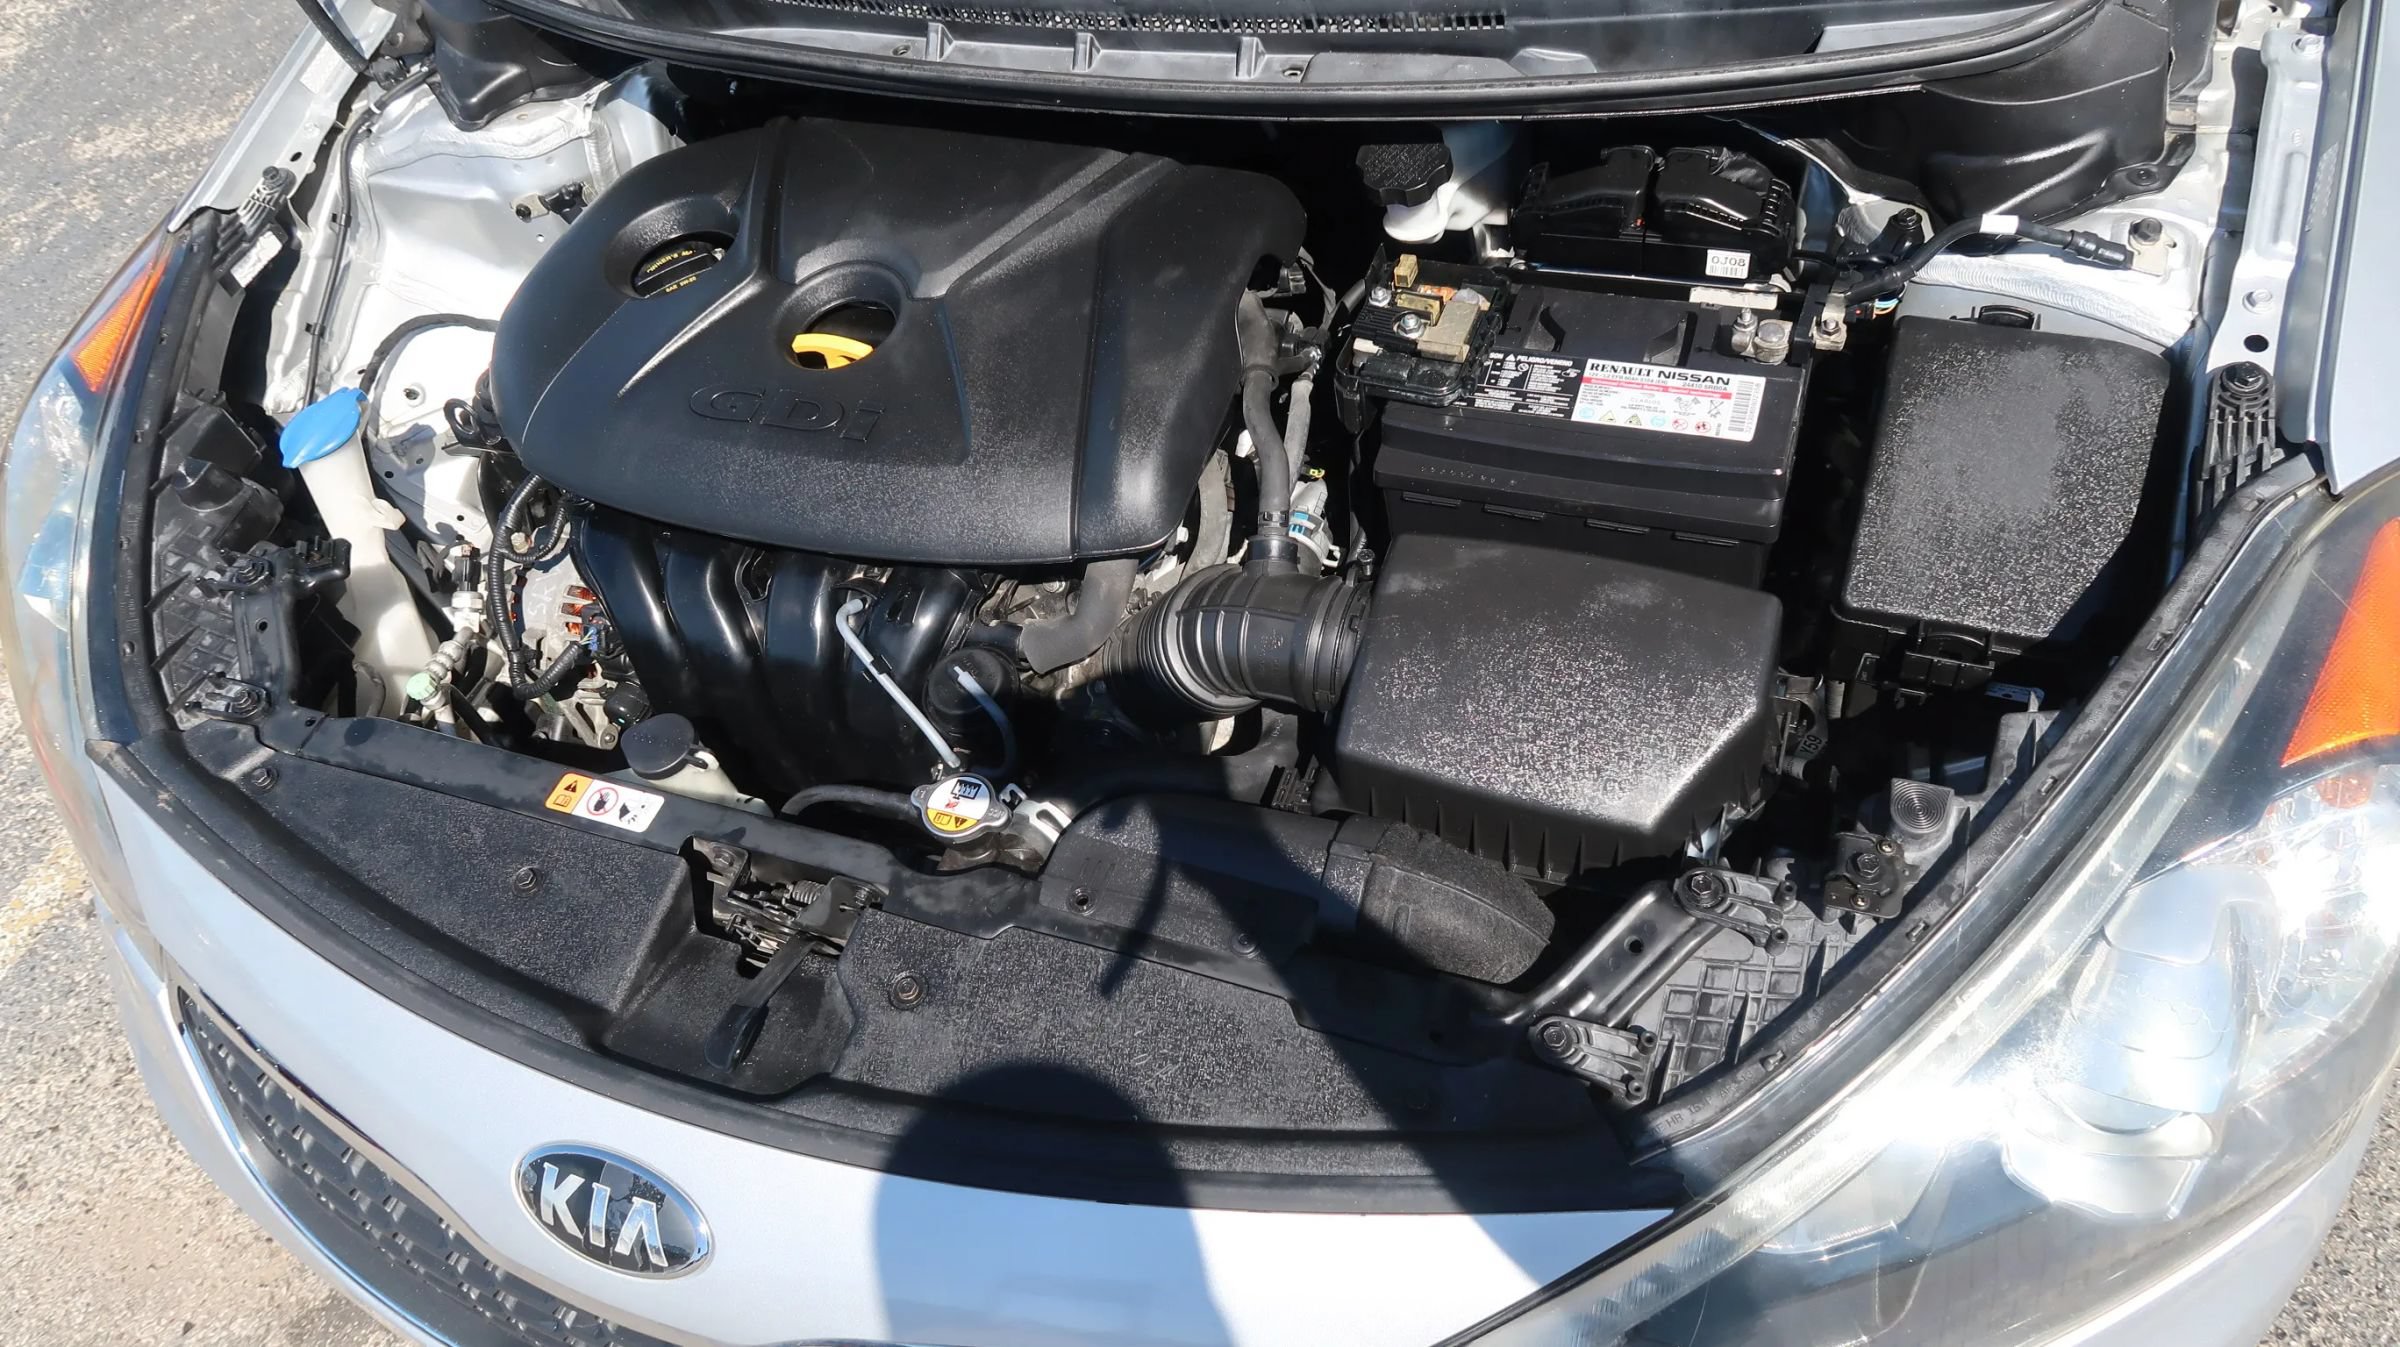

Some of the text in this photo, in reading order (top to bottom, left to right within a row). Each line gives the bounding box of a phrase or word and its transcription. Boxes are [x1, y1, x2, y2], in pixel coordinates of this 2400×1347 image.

[1590, 363, 1653, 377] RENAULT
[1657, 370, 1730, 385] NISSAN
[1800, 735, 1822, 754] Y59
[541, 1162, 668, 1267] KIA
